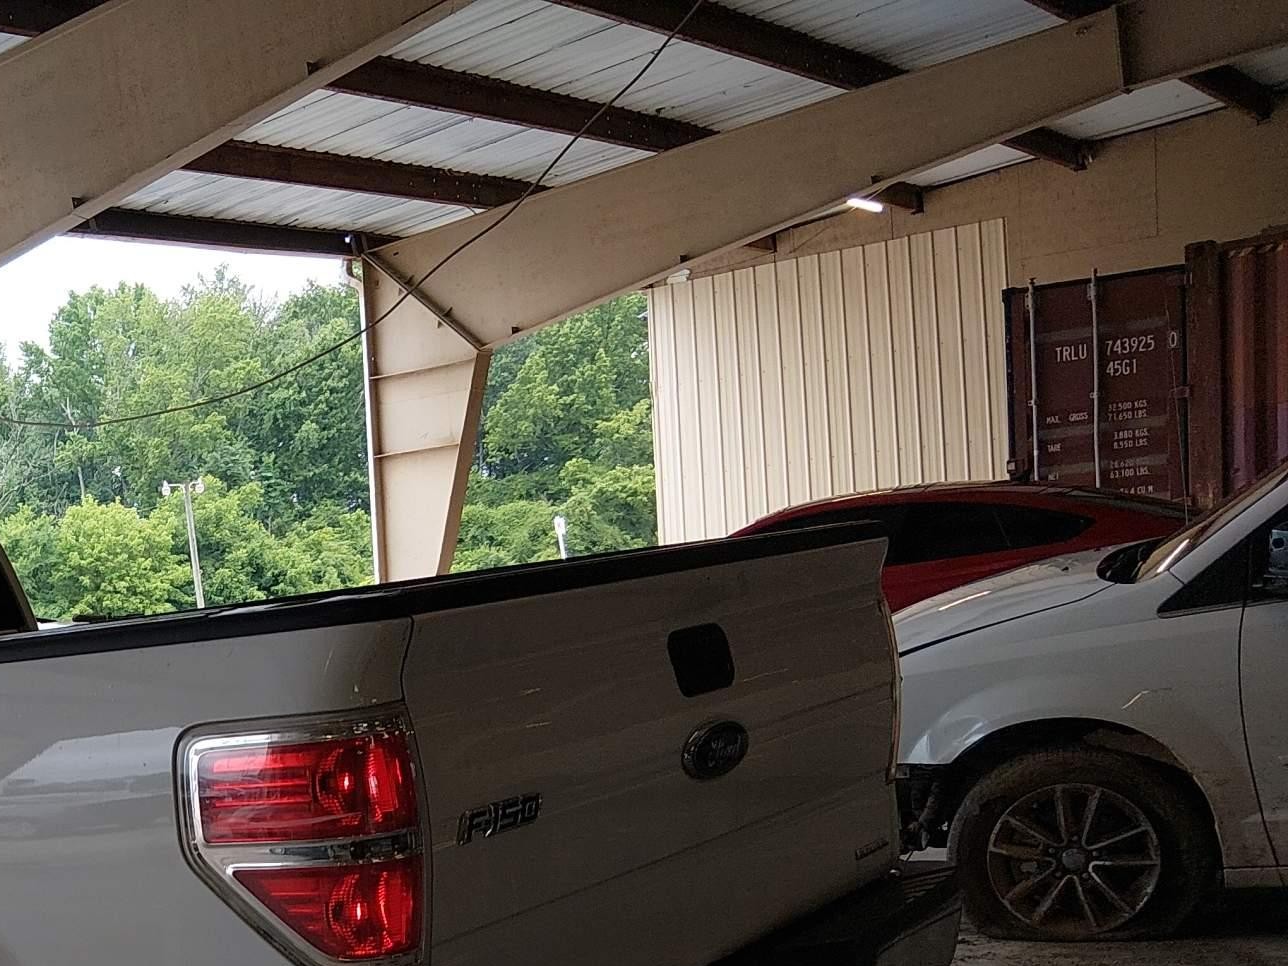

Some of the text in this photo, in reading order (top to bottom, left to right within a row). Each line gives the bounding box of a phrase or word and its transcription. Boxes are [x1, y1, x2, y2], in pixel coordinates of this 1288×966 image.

[1055, 331, 1177, 362] TRLU 743925 0
[1106, 359, 1137, 376] 45G1
